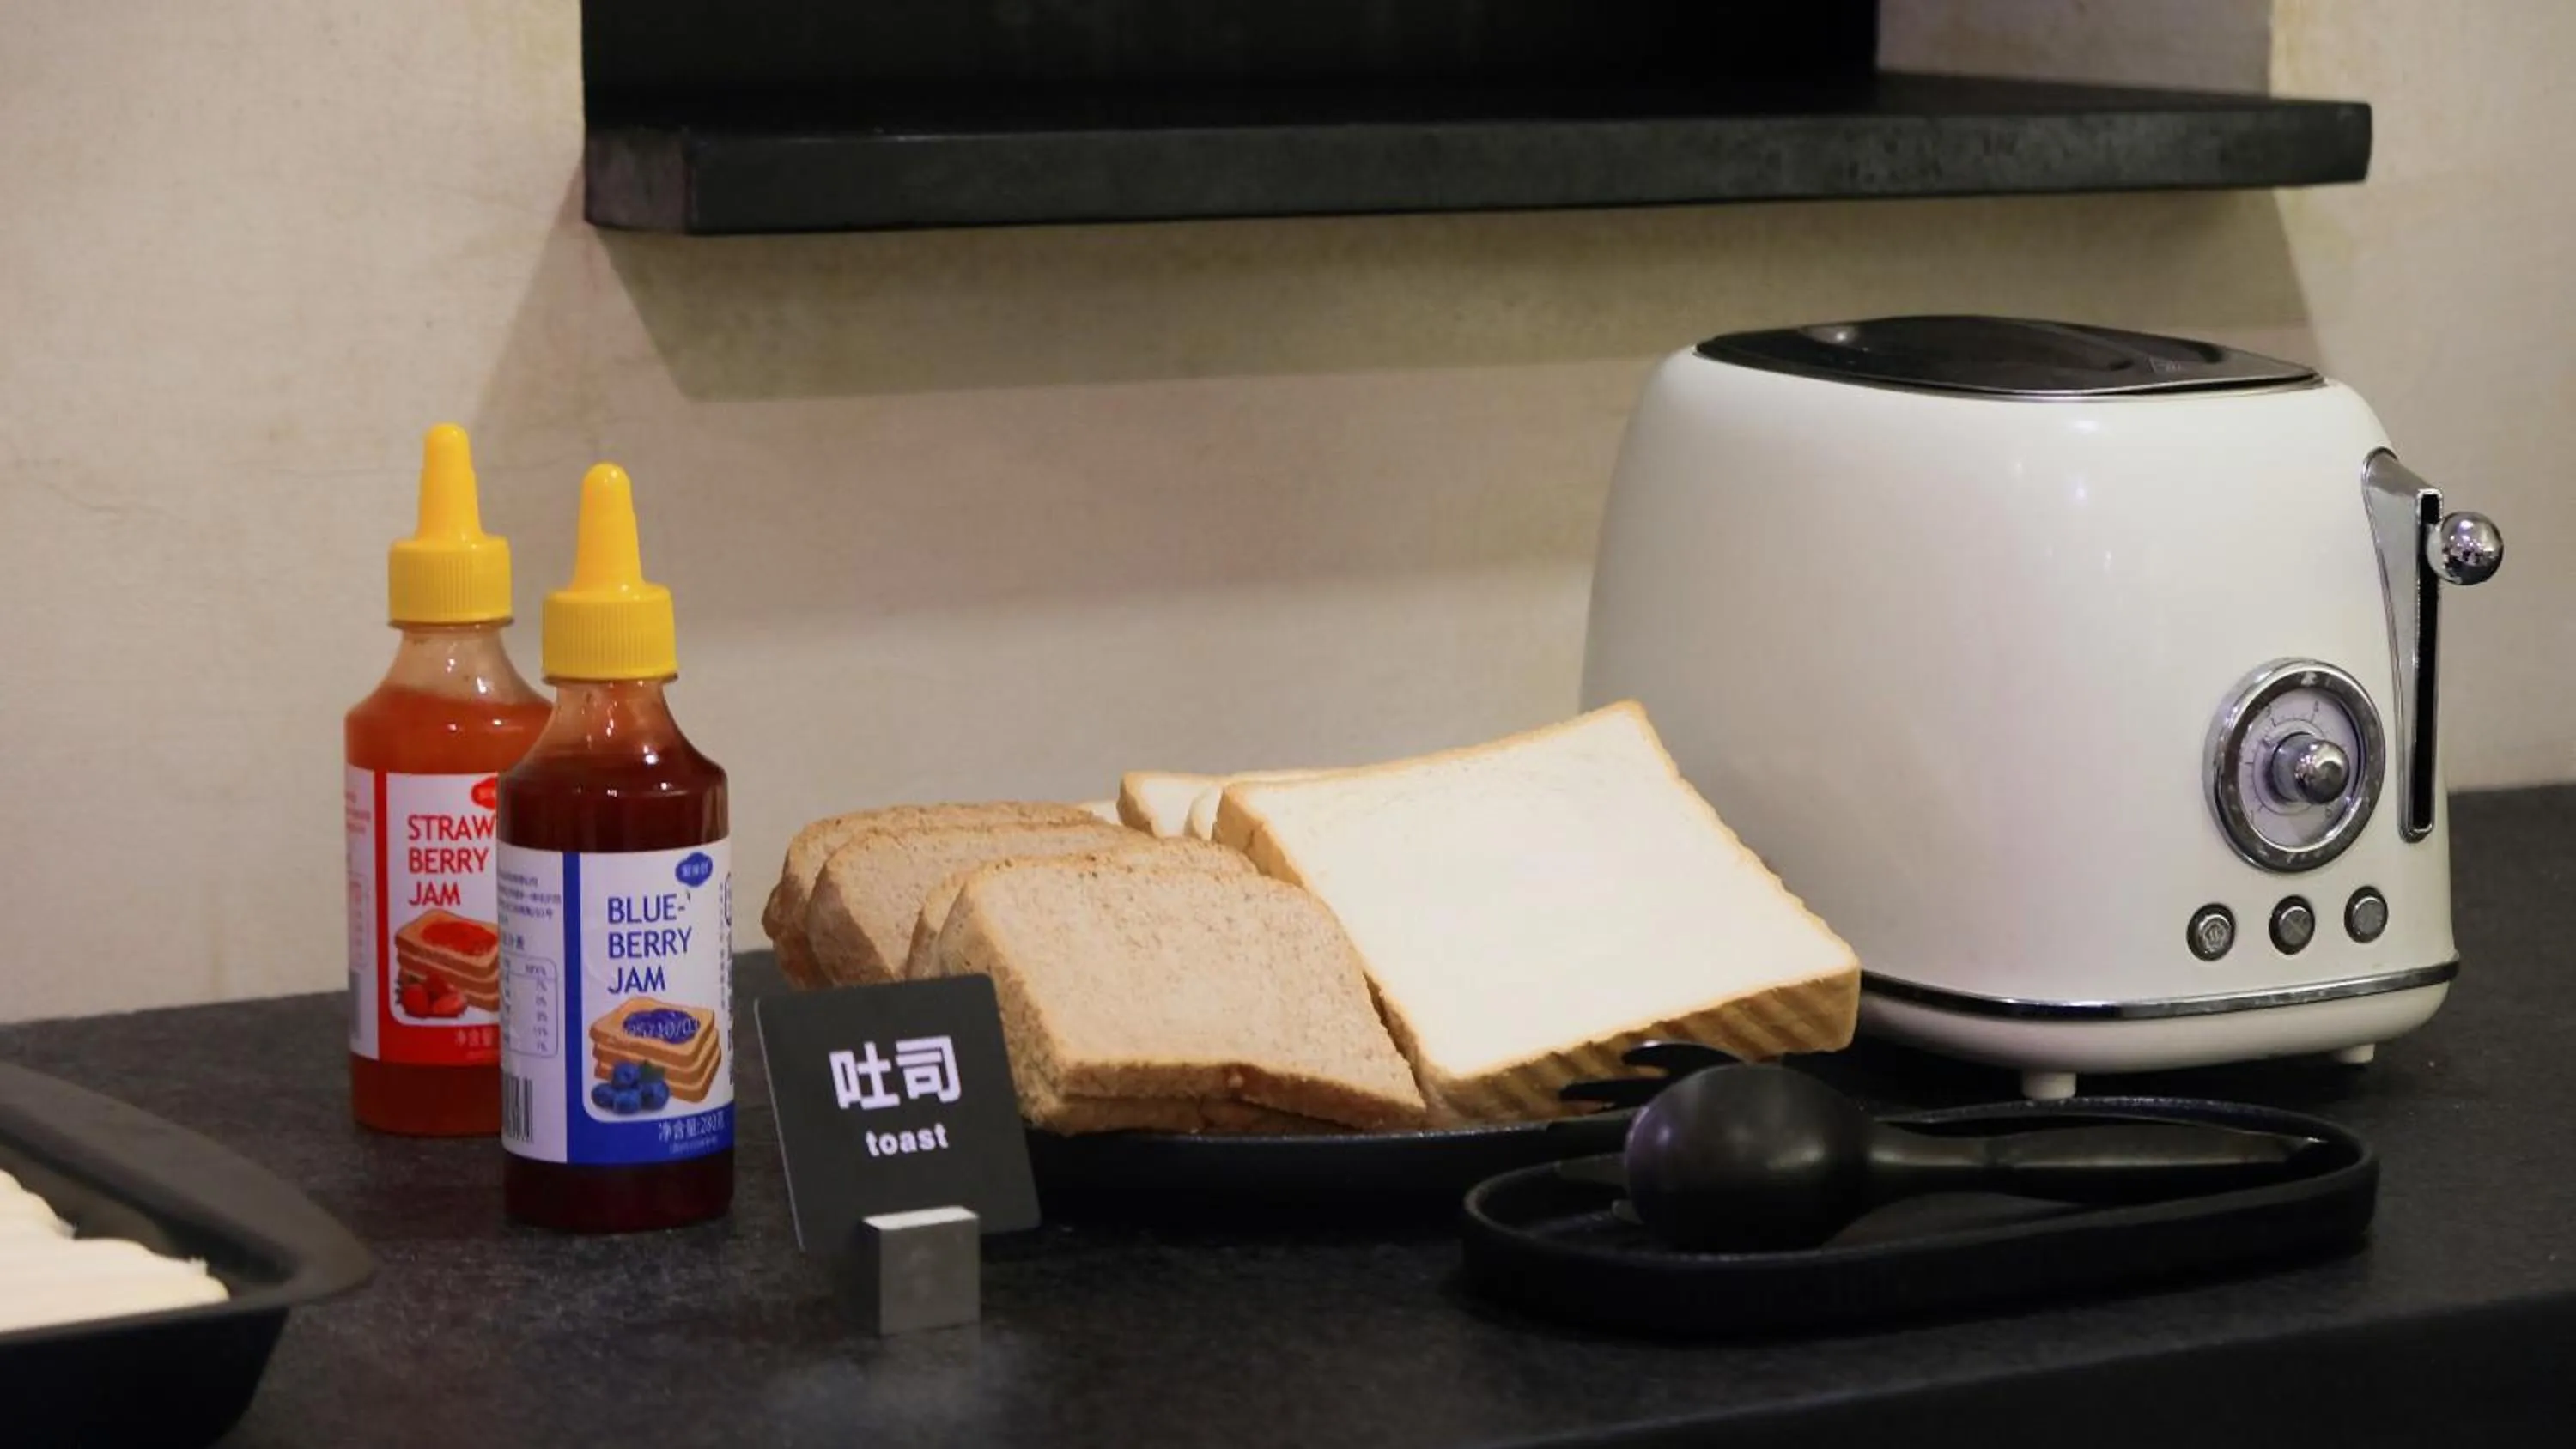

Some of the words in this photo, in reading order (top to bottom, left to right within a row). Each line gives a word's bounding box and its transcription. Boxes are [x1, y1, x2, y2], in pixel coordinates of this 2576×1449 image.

[407, 814, 496, 840] STRAW
[408, 846, 489, 874] BERRY
[408, 880, 461, 906] JAM
[607, 894, 685, 924] BLUE-
[608, 925, 692, 959] BERRY
[607, 965, 665, 994] JAM
[829, 1035, 962, 1110] 吐司
[866, 1123, 949, 1157] toast
